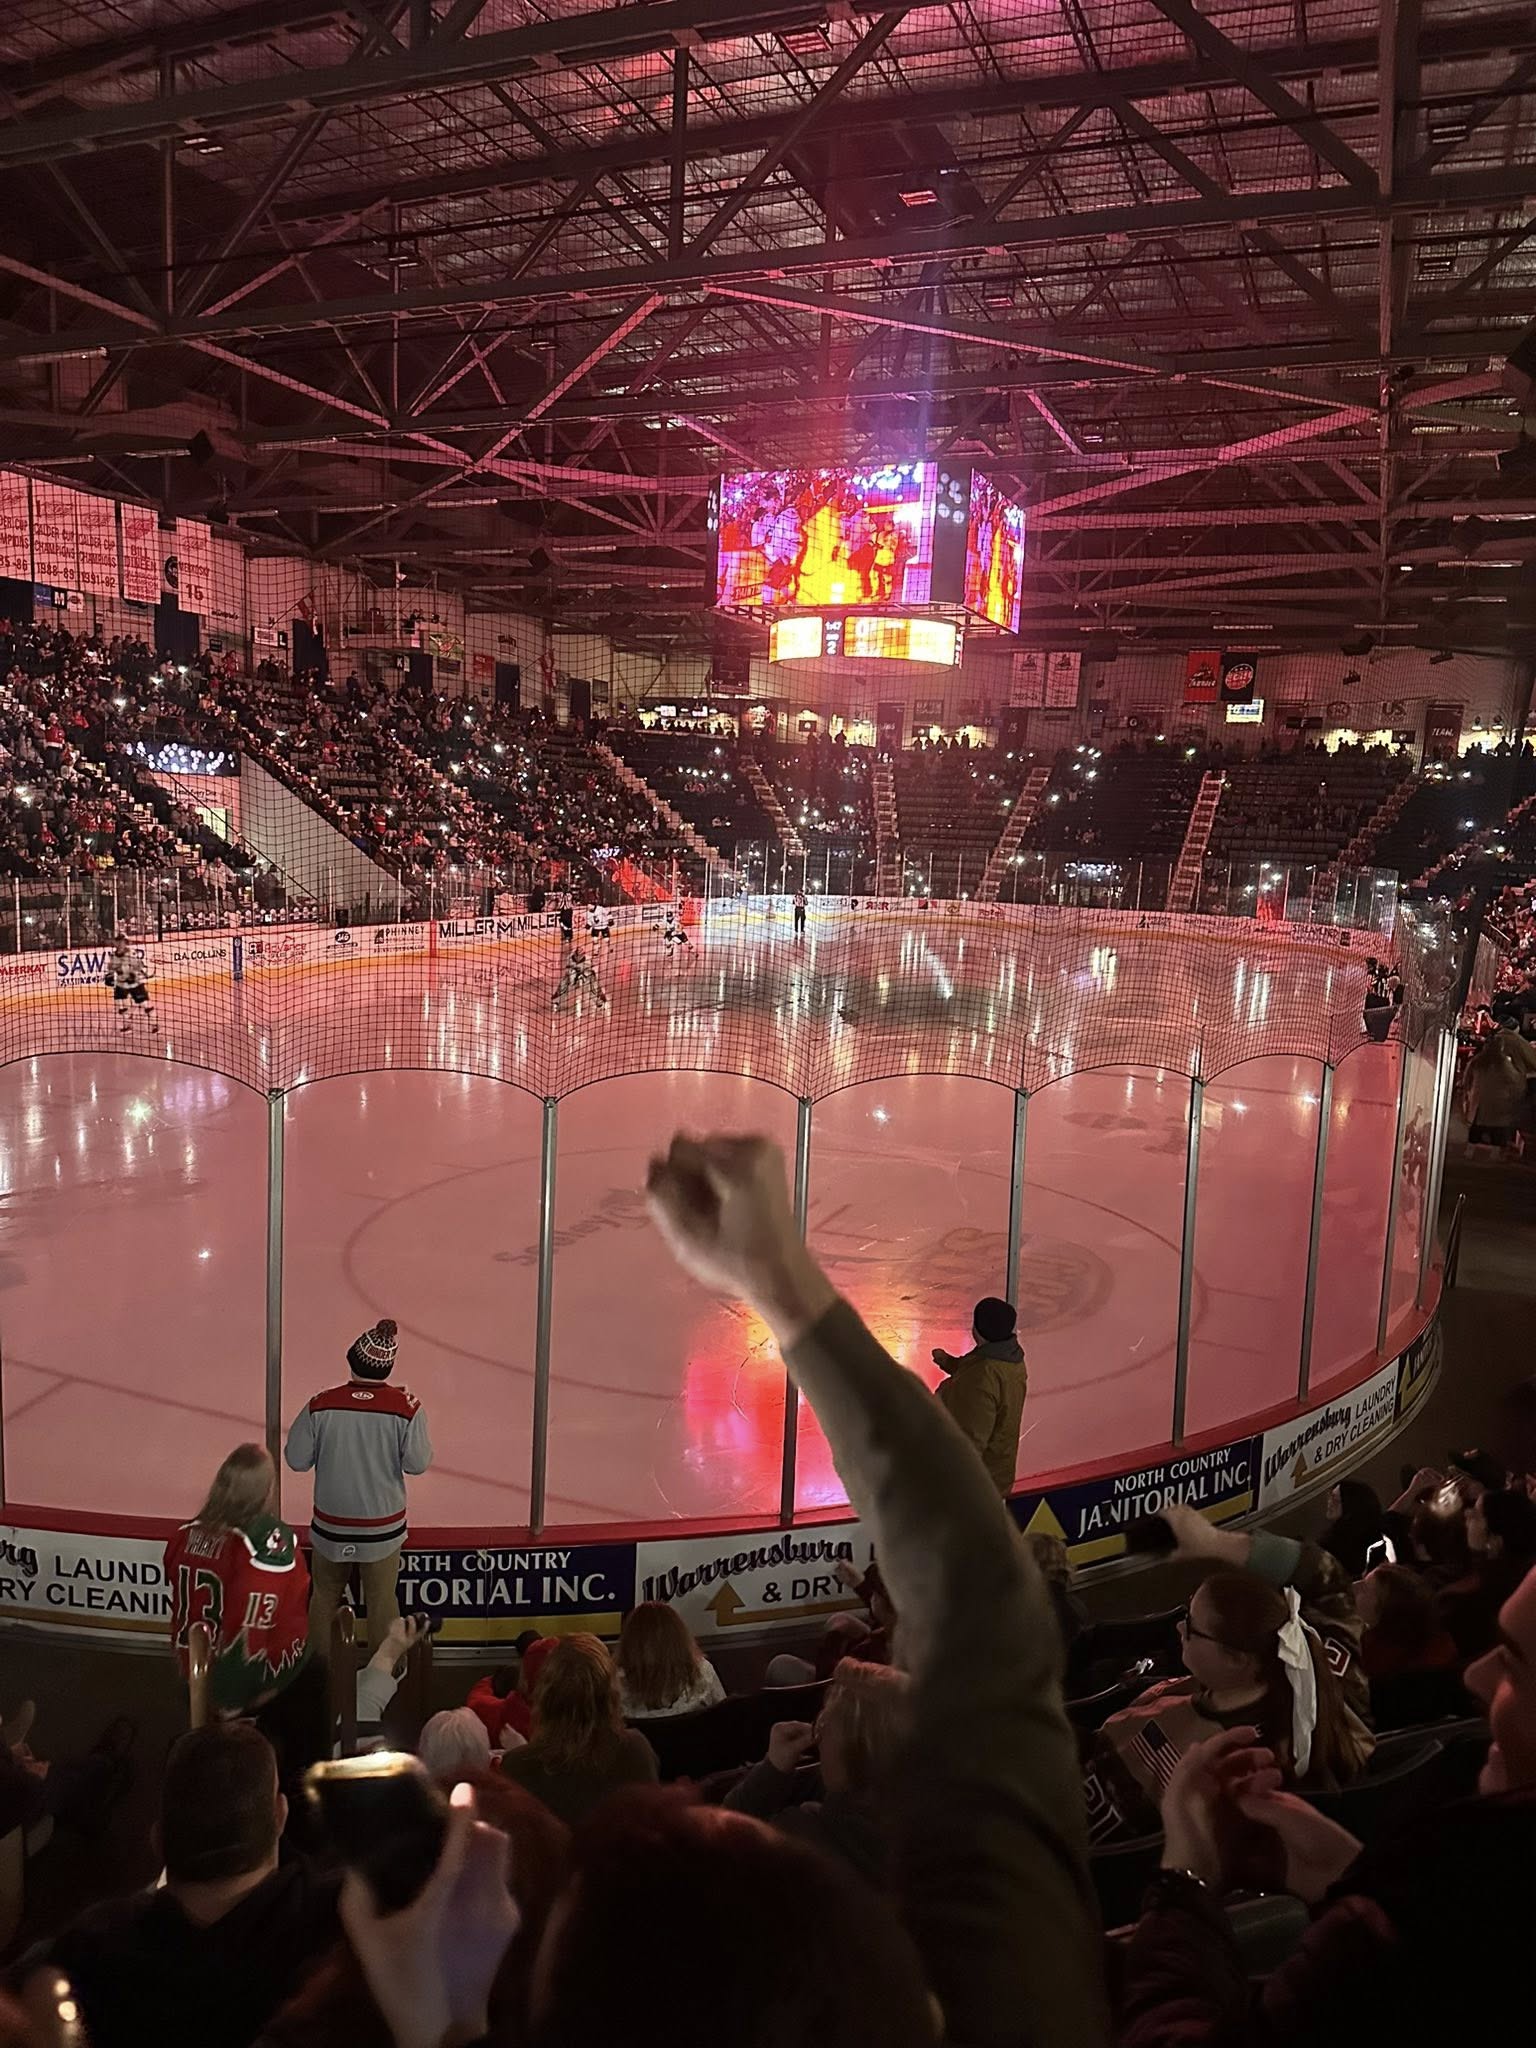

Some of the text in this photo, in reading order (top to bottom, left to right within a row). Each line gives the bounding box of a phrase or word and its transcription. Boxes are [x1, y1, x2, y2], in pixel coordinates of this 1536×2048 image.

[34, 522, 60, 539] CALDER
[34, 540, 76, 560] CHAMPIONS
[185, 583, 204, 601] 15
[385, 925, 426, 937] PHINNEY
[439, 918, 494, 939] MILLER
[191, 948, 227, 961] COLLINS
[1263, 1375, 1397, 1488] Warrensburg LAUNDRY
[1314, 1396, 1395, 1465] & DRY CLEANING
[1113, 1447, 1232, 1495] NORTH COUNTRY
[1213, 1460, 1252, 1495] INC.
[55, 1555, 170, 1588] LAUND
[461, 1550, 572, 1572] COUNTRY
[46, 1582, 174, 1616] CLEANIN
[541, 1573, 616, 1604] INC.
[762, 1573, 845, 1604] & DRY
[242, 1591, 280, 1630] 13
